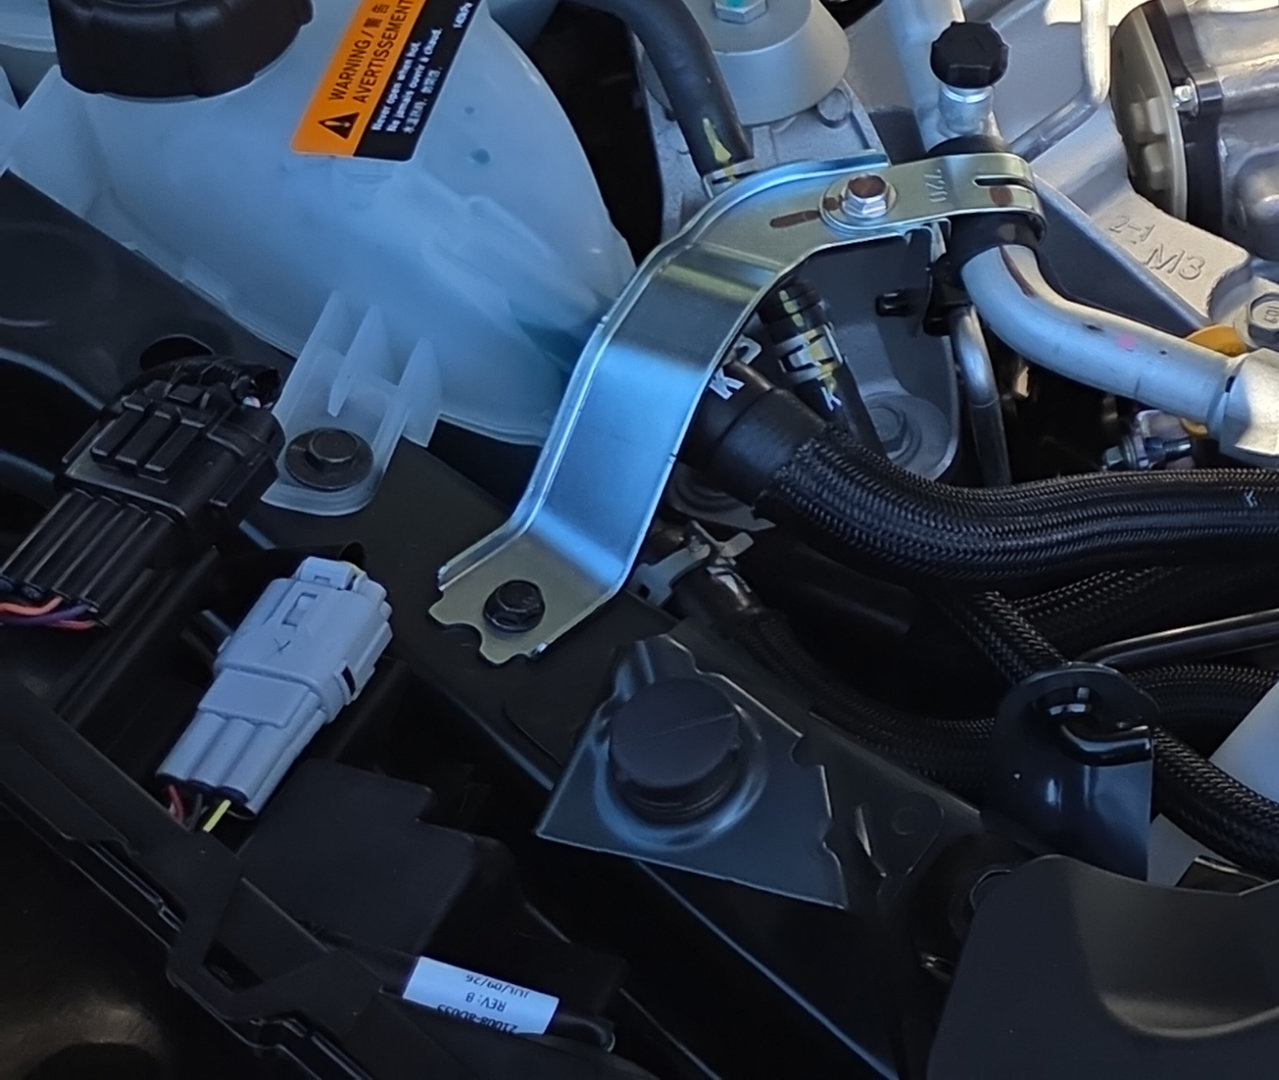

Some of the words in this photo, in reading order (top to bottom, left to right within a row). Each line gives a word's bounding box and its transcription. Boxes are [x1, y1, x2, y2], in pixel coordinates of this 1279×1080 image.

[328, 39, 372, 101] WARNING
[371, 106, 391, 131] Never
[386, 84, 402, 105] open
[1143, 242, 1206, 281] M3
[465, 991, 476, 1003] B
[477, 995, 507, 1012] REV:
